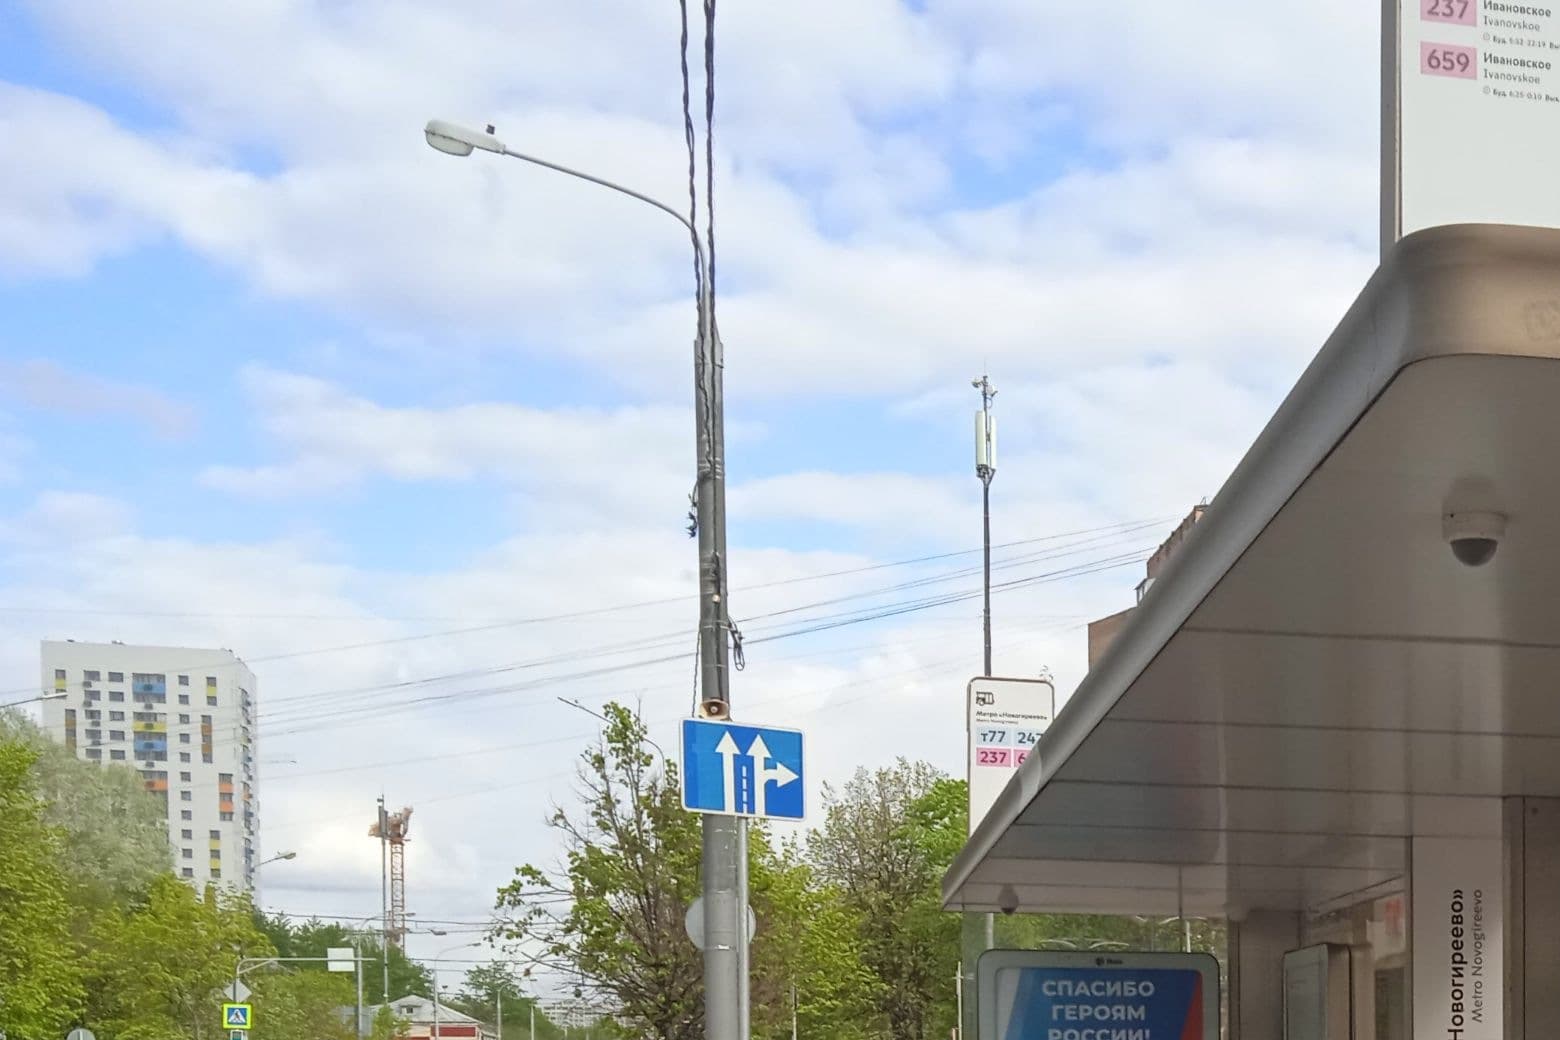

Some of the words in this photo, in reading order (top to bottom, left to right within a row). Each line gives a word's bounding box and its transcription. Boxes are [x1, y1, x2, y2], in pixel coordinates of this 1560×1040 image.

[1427, 0, 1469, 20] 237
[1484, 0, 1552, 18] Ивановское
[1484, 16, 1540, 32] Ivanovskoe
[1427, 49, 1470, 73] 659
[1484, 52, 1552, 71] Ивановское
[1484, 69, 1540, 84] Ivanovskoe
[980, 751, 1007, 764] 237
[1472, 888, 1486, 977] Novogireevo
[1041, 980, 1155, 998] СПАСИБО
[1472, 980, 1483, 1023] Metro
[1052, 1004, 1145, 1021] ГЕРОЯМ
